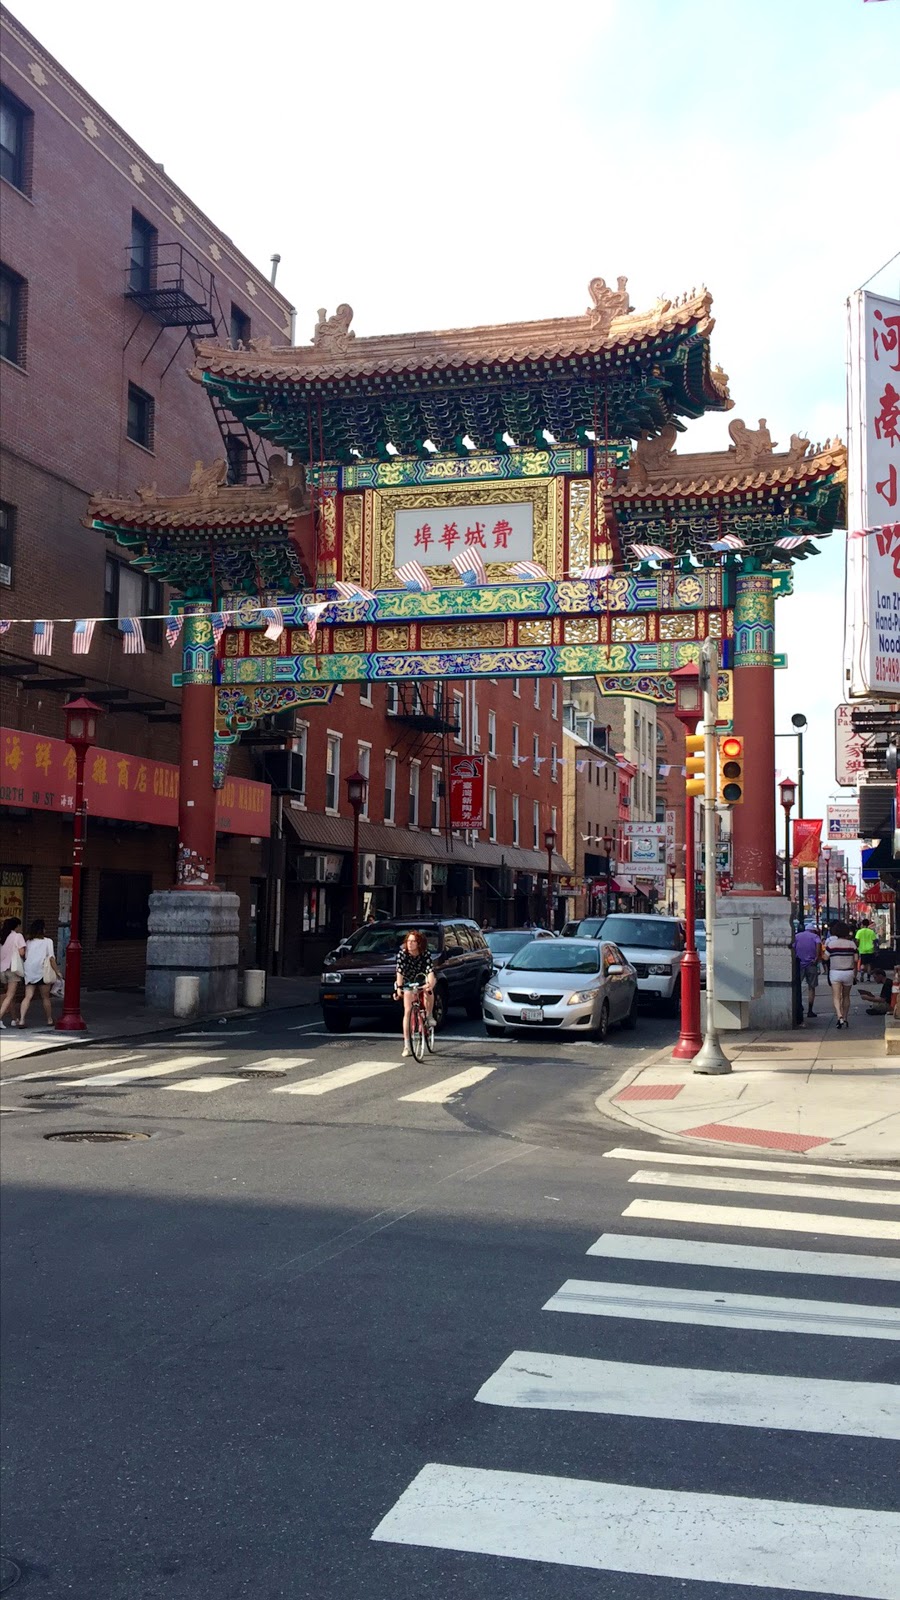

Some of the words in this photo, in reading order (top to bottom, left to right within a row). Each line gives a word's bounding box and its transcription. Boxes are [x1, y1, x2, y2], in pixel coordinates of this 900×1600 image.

[877, 590, 891, 610] Lan
[44, 792, 55, 806] ST
[154, 767, 180, 800] GREAT
[239, 784, 265, 813] MARKET
